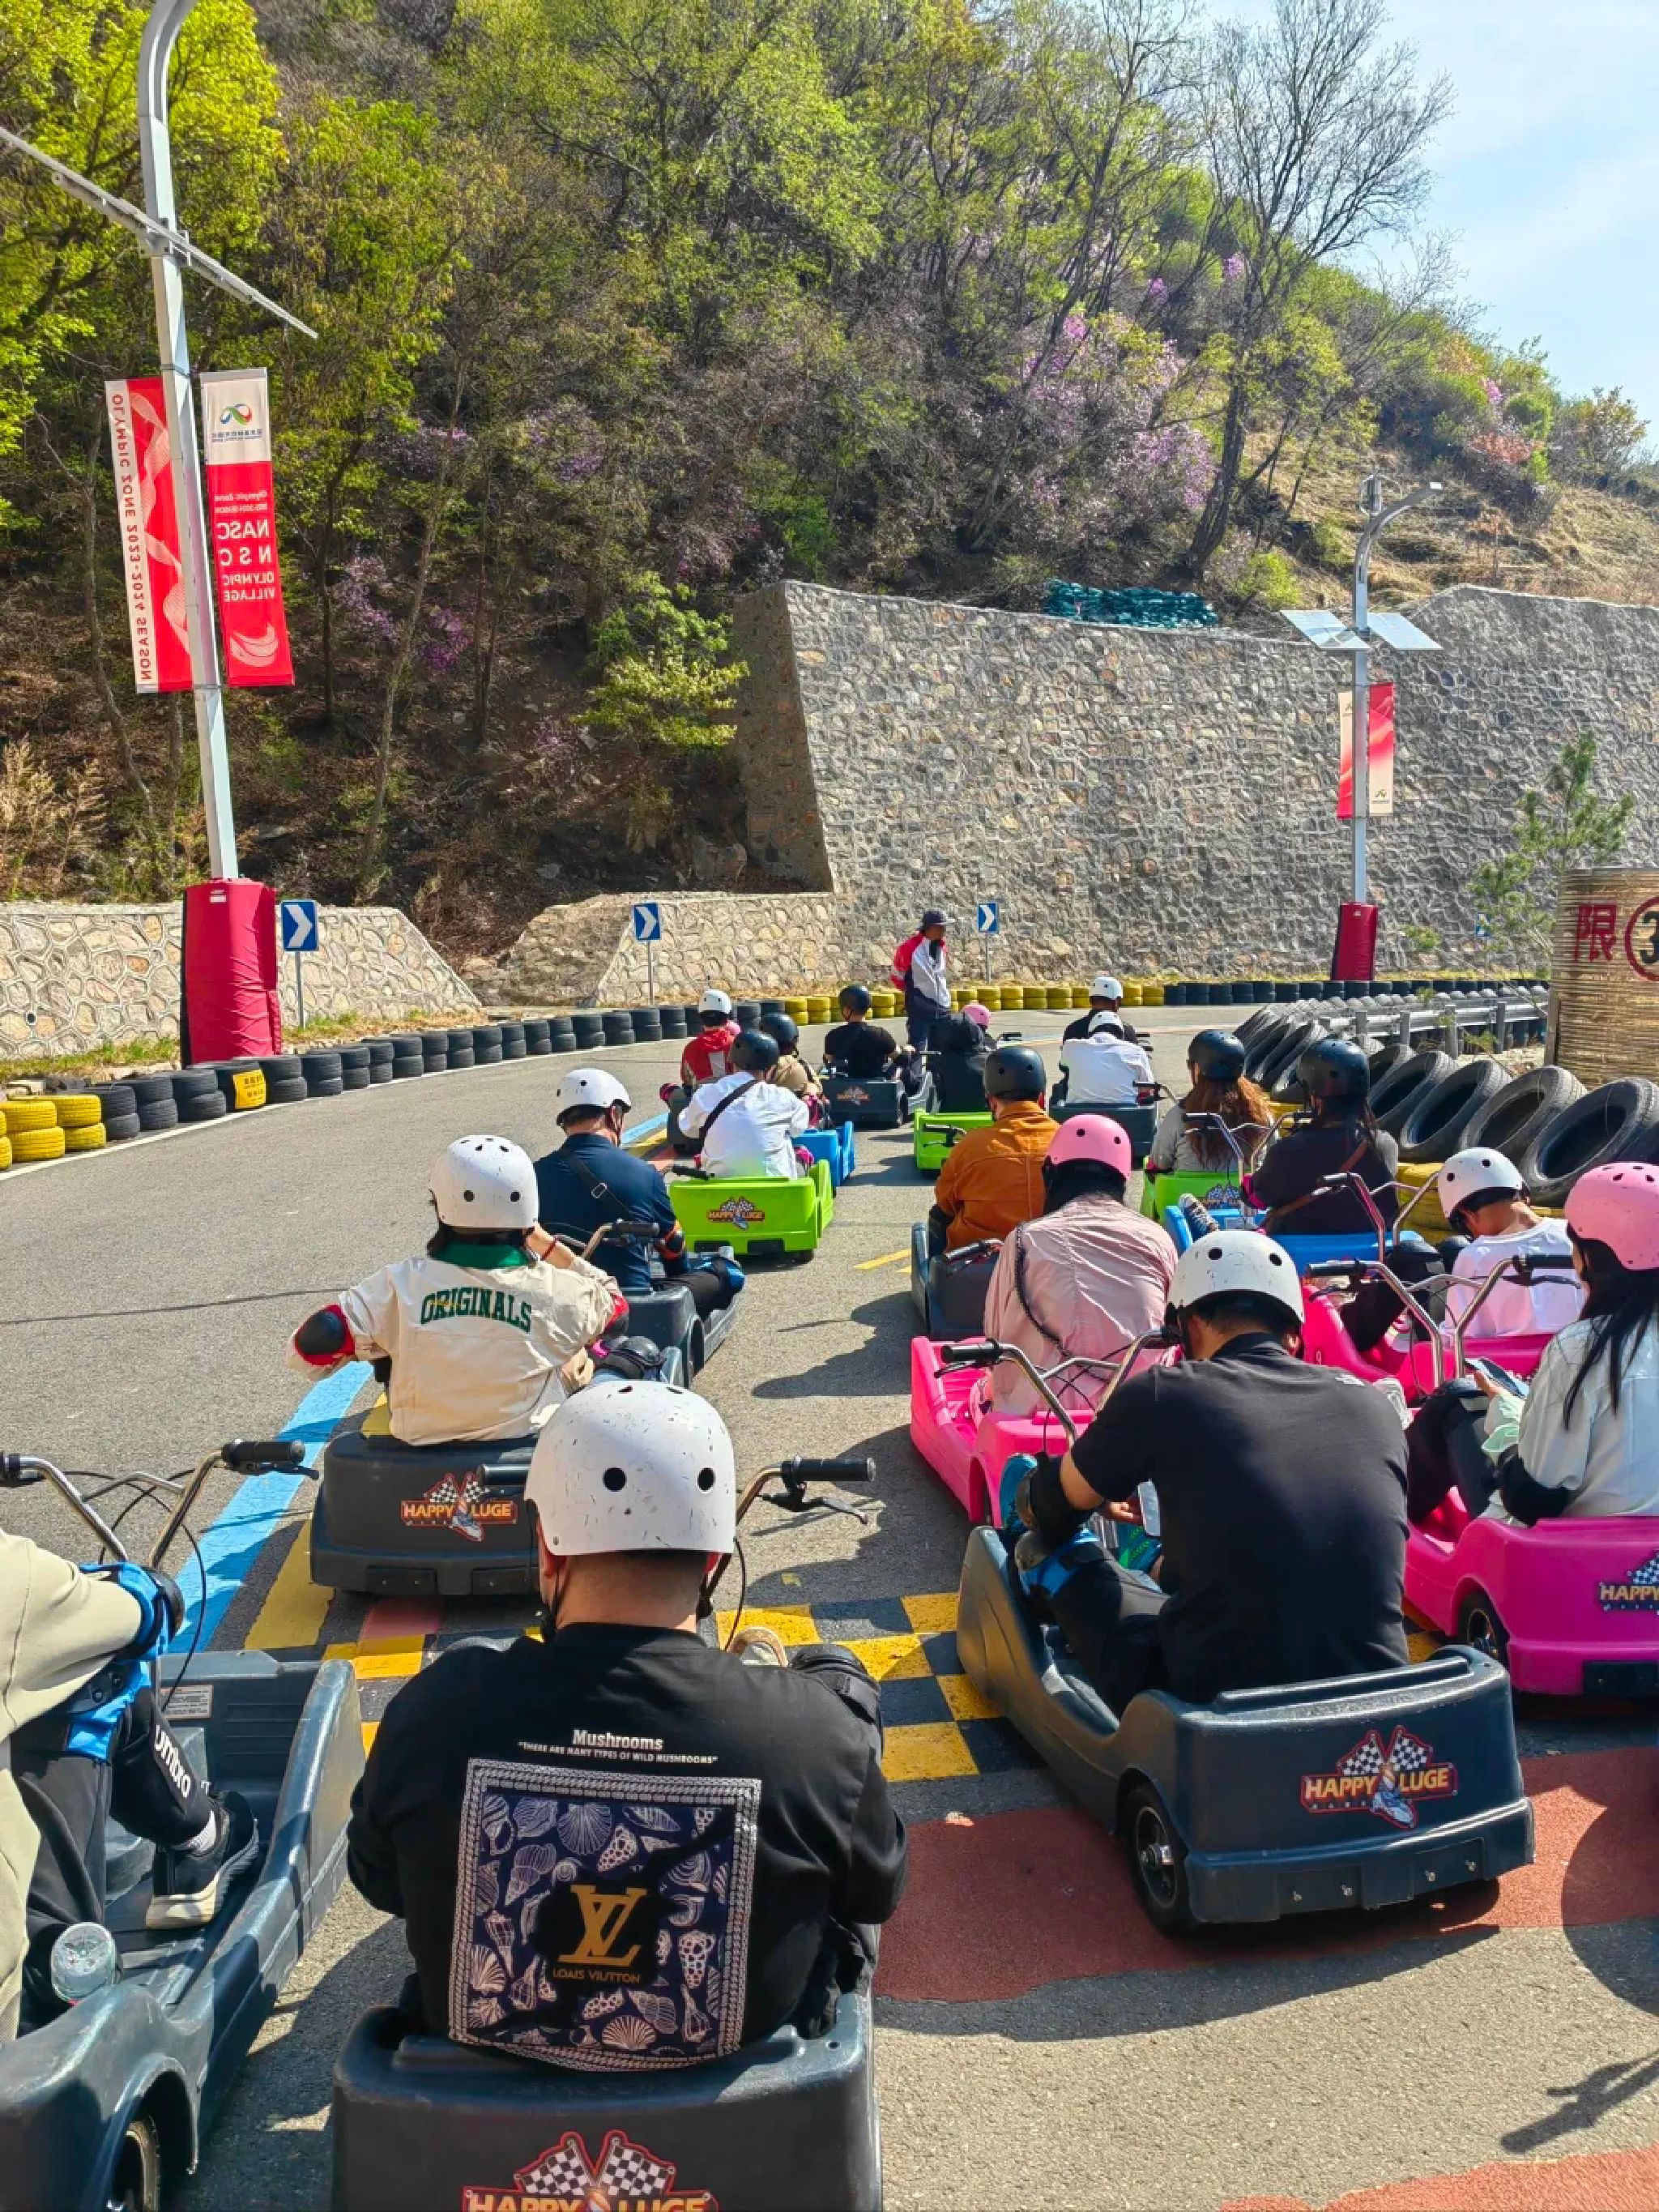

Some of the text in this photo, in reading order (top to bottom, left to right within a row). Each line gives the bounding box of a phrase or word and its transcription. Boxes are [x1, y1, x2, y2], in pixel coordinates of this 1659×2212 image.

[1574, 903, 1618, 963] 限
[420, 1286, 532, 1334] ORIGINALS
[403, 1503, 511, 1518] HAPPY LUGE
[1602, 1586, 1659, 1600] HAPPY
[572, 1728, 664, 1750] Mushrooms
[1305, 1767, 1449, 1799] HAPPY LUGE
[468, 2193, 582, 2212] HAPPY
